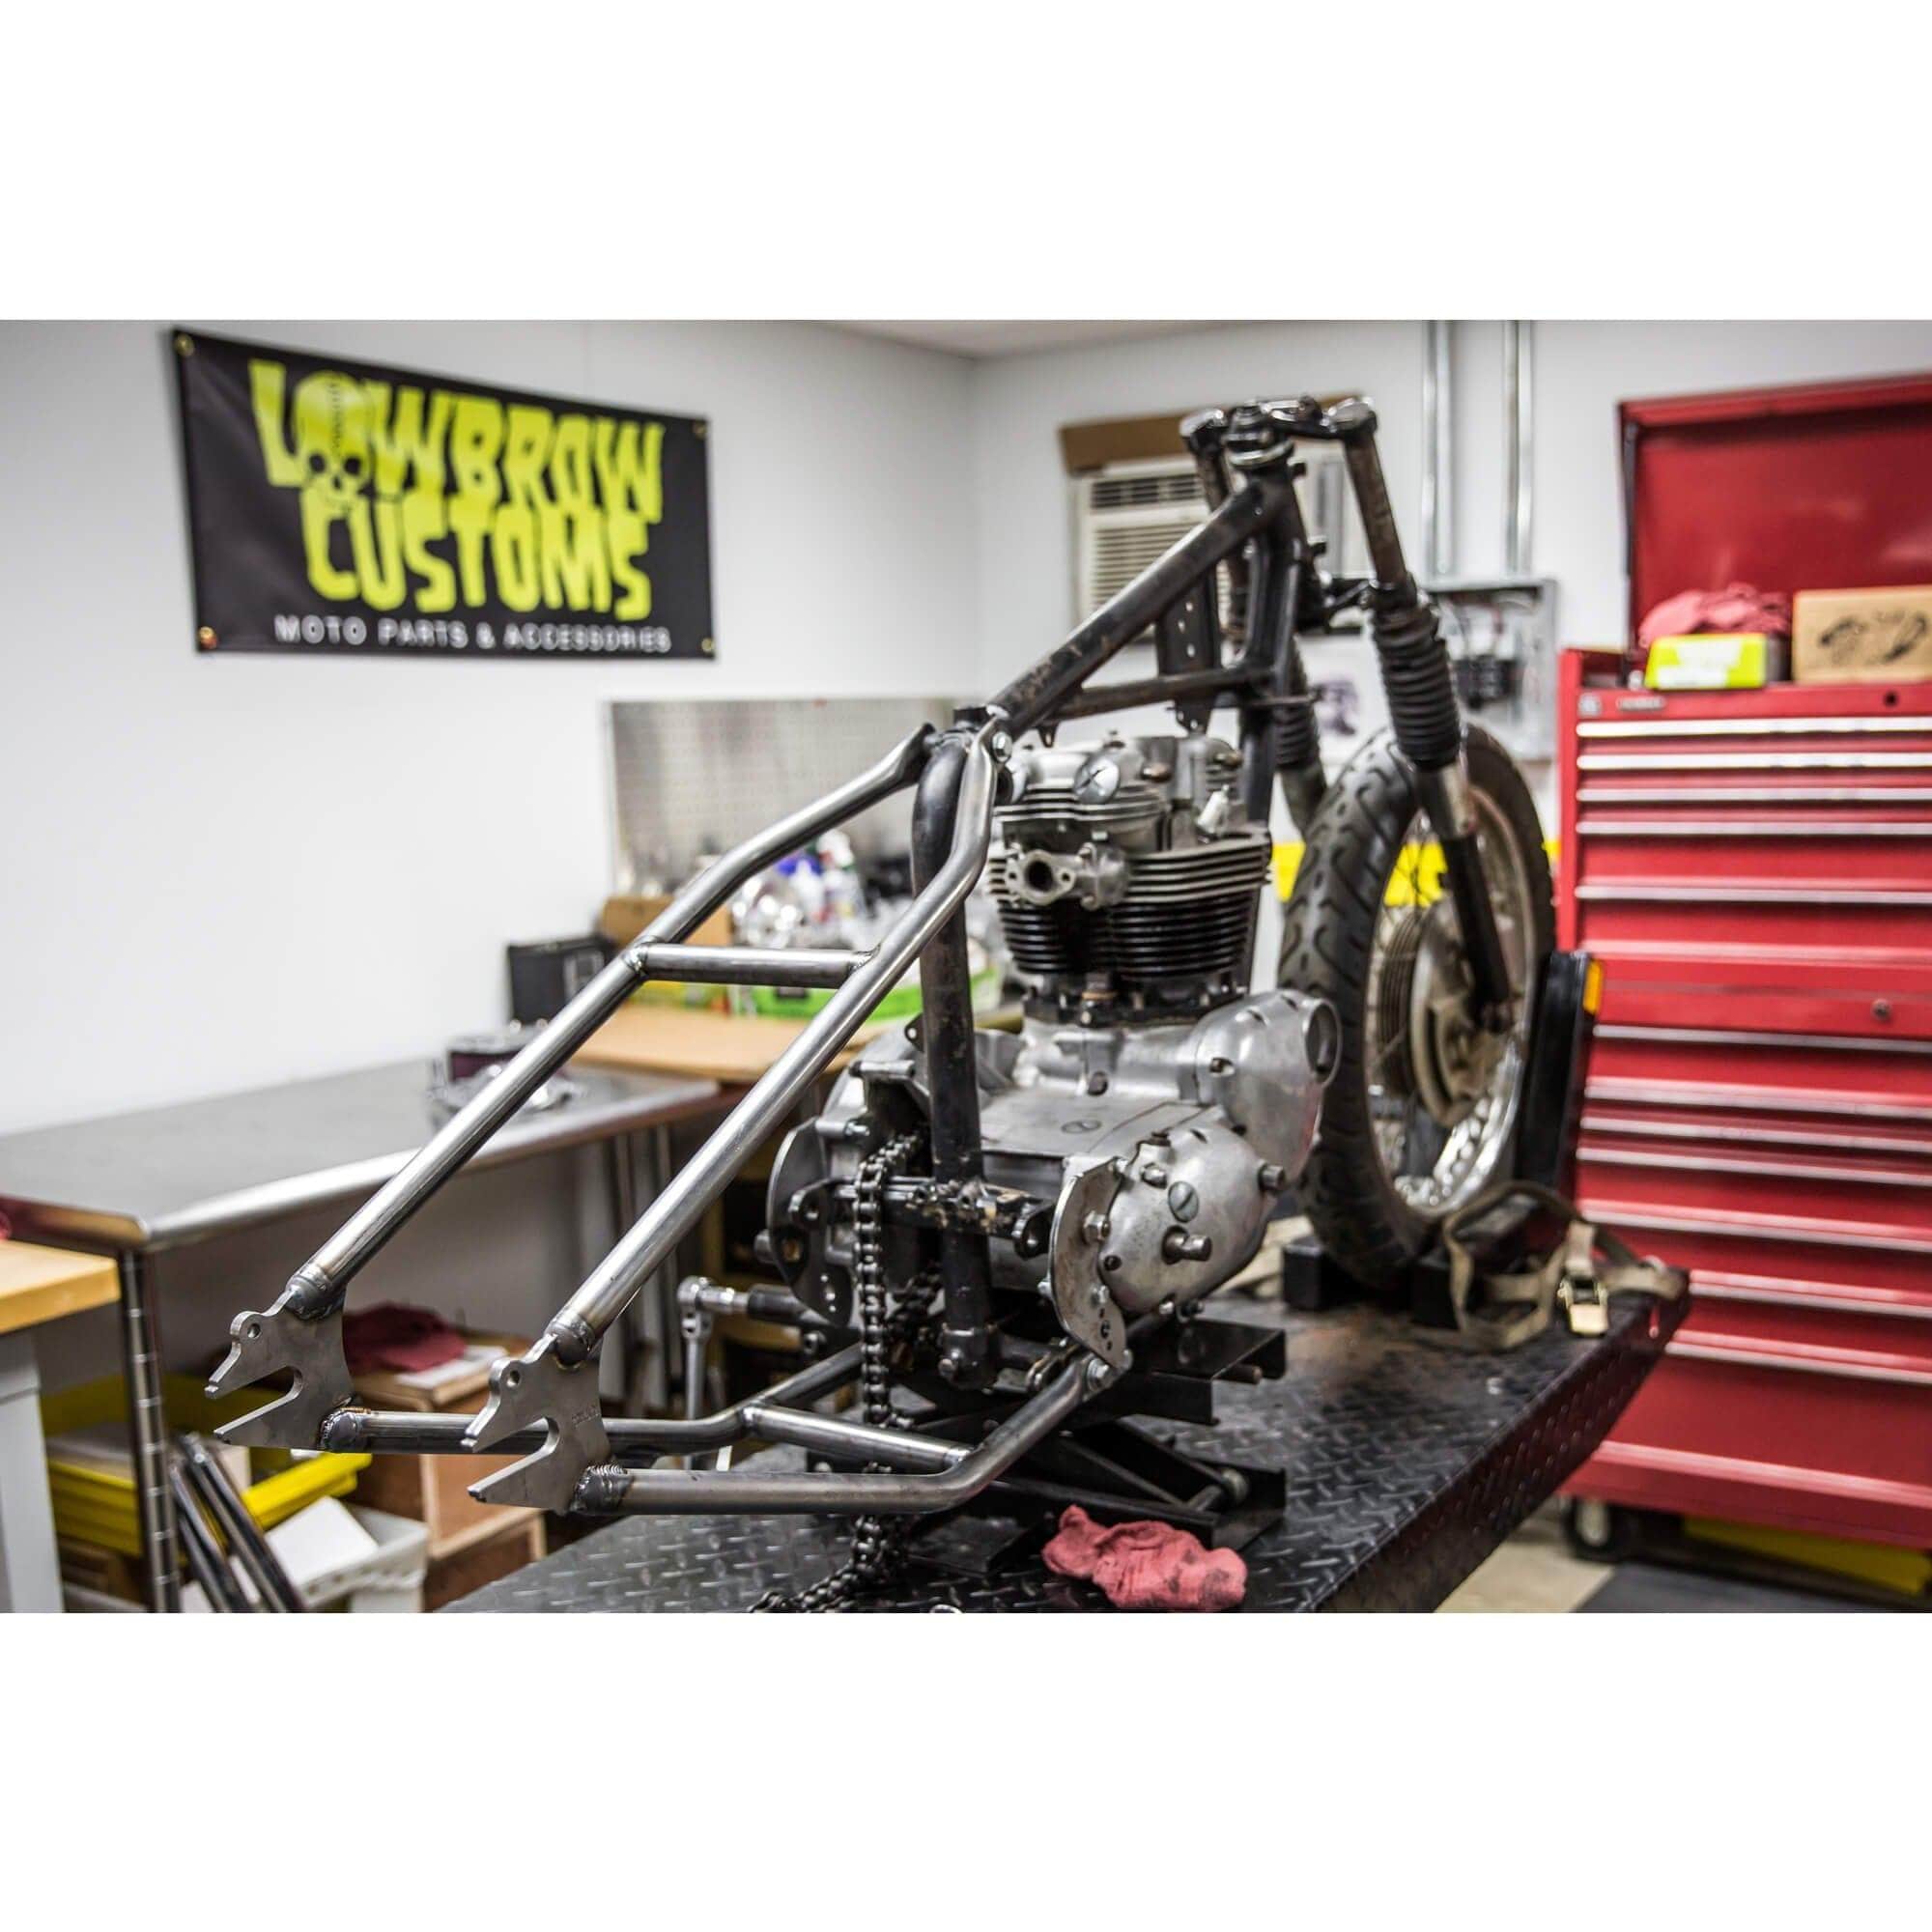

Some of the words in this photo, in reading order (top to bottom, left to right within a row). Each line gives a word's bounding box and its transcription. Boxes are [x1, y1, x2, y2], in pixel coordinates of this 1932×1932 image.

[248, 359, 665, 524] LOWBROW
[299, 486, 653, 621] CUSTOMS
[274, 614, 368, 645] MOTO
[378, 617, 469, 649] PARTS
[475, 621, 497, 650] &
[502, 622, 672, 653] ACCESSORIES
